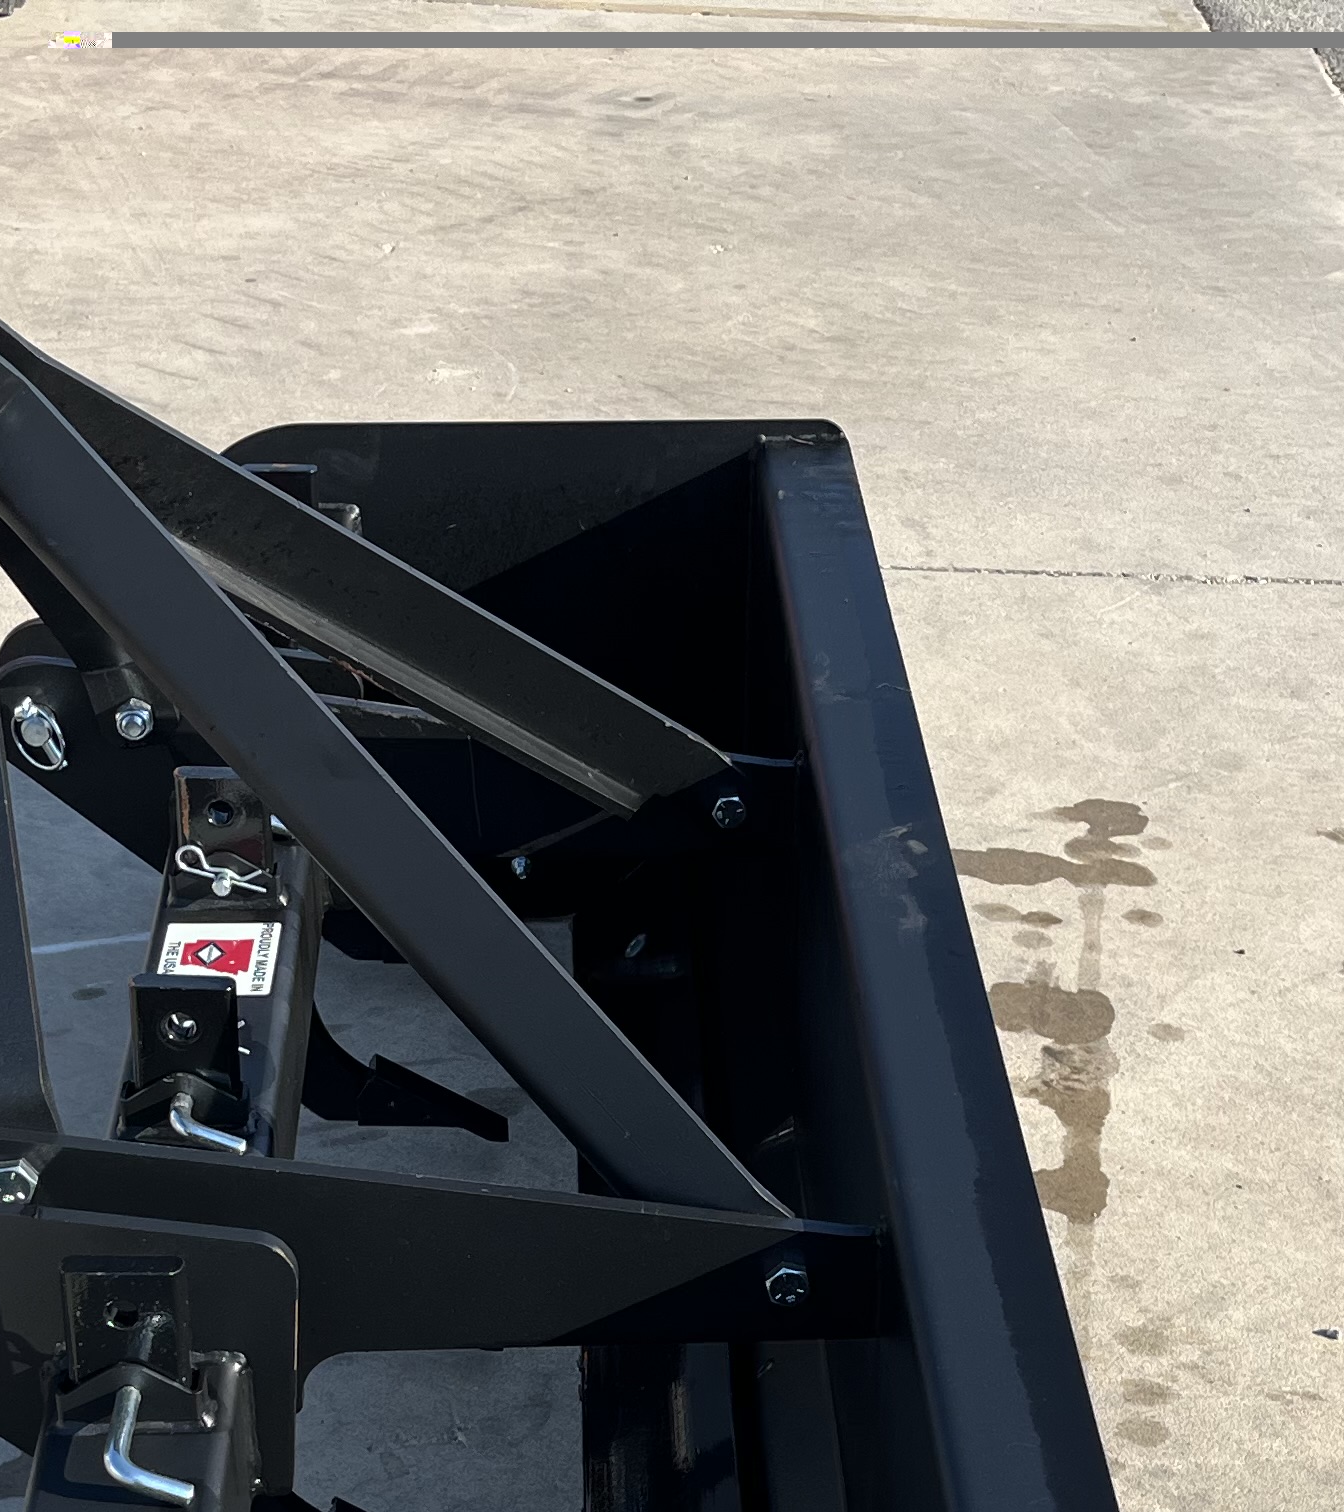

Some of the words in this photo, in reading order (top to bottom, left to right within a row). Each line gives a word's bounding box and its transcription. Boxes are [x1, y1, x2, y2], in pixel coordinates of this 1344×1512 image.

[166, 941, 181, 956] THE
[257, 922, 275, 958] PROUDLY
[162, 957, 177, 974] USA
[252, 959, 268, 982] MADE
[250, 983, 264, 992] IN
